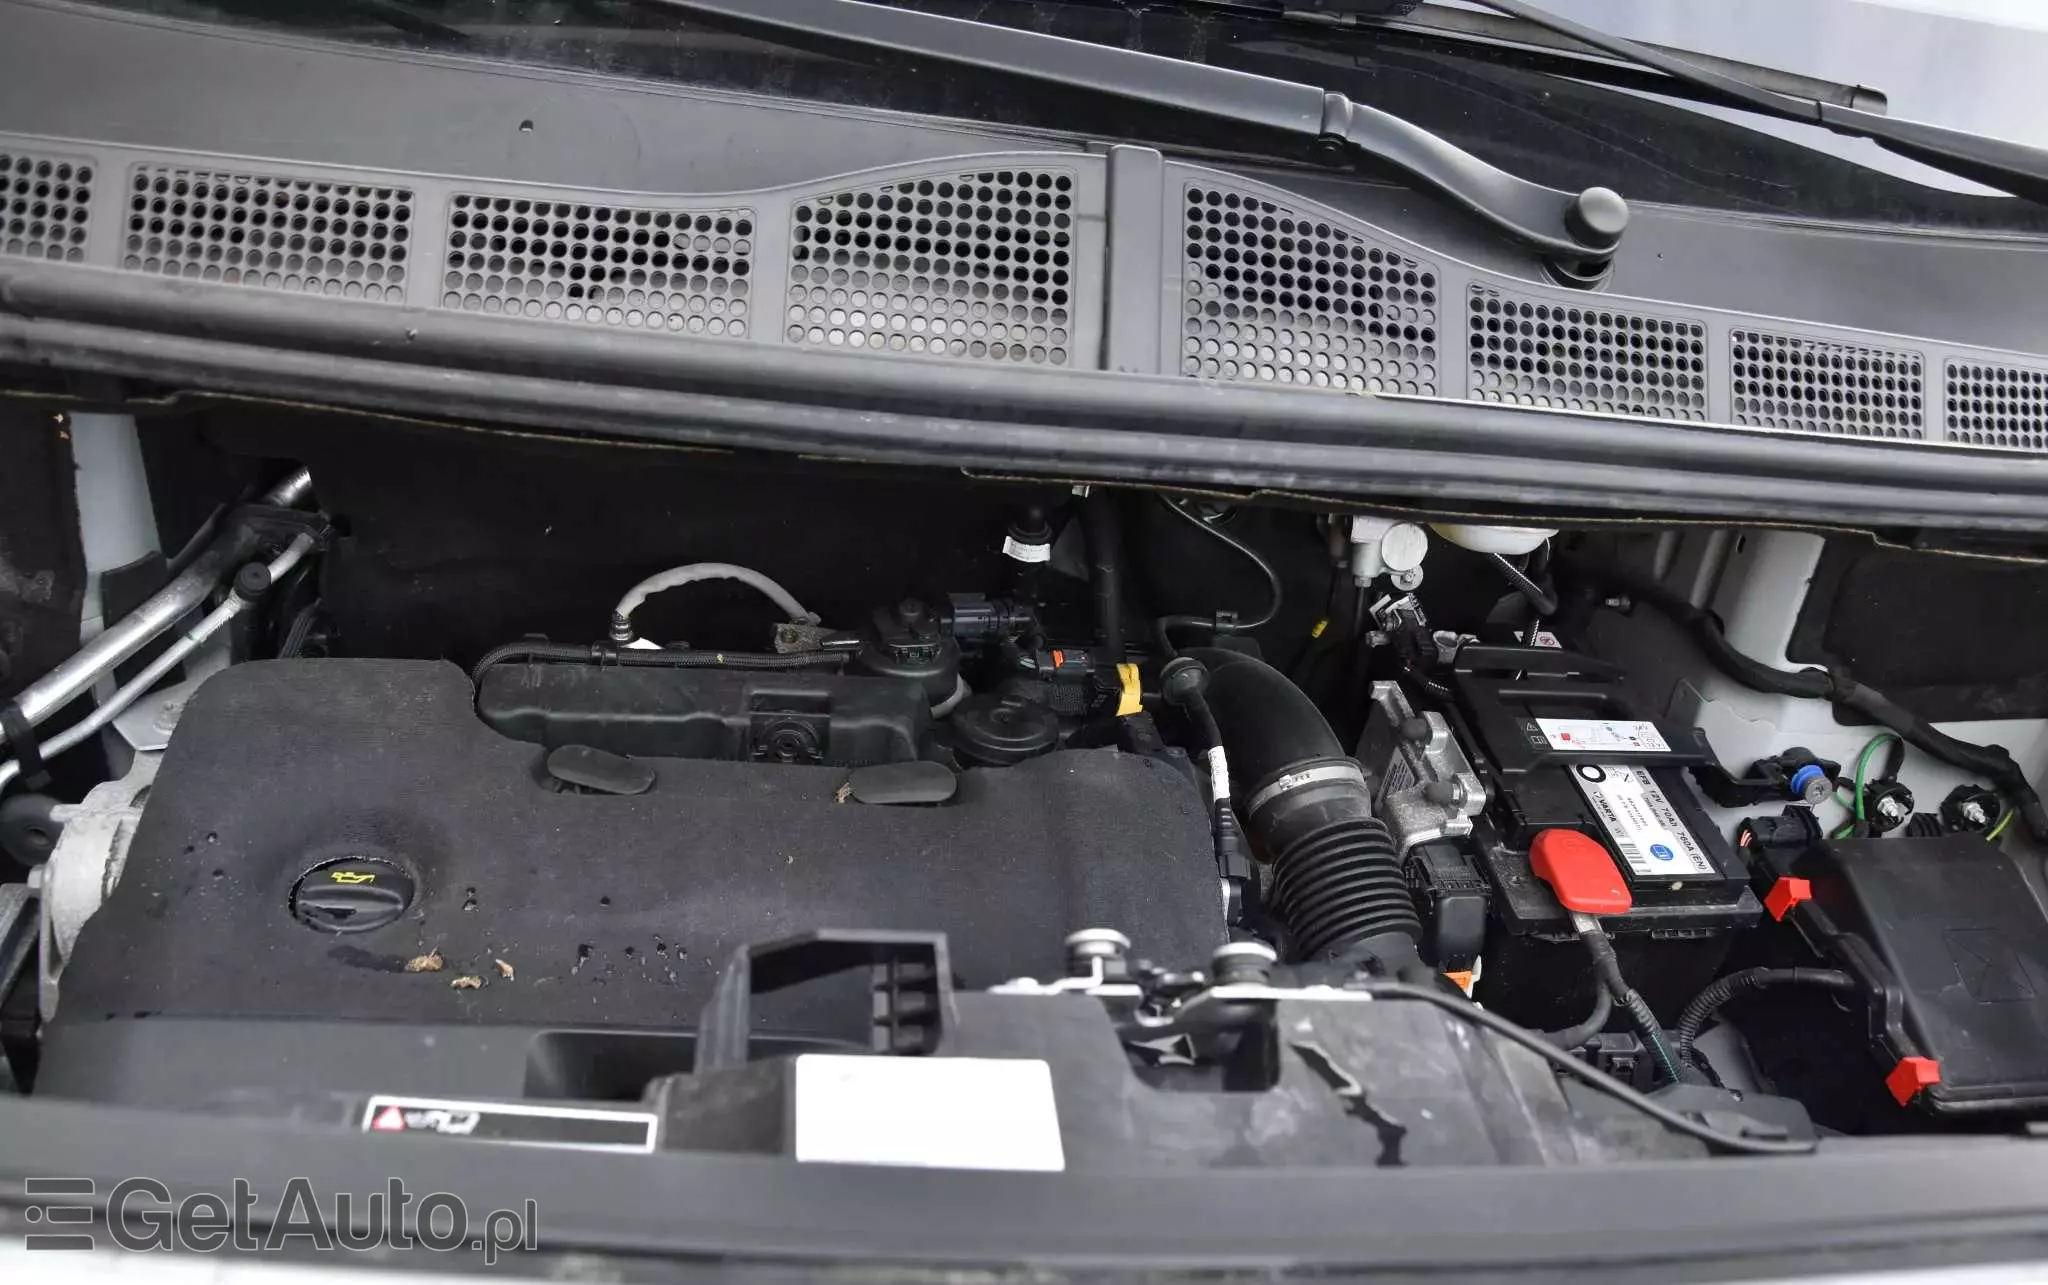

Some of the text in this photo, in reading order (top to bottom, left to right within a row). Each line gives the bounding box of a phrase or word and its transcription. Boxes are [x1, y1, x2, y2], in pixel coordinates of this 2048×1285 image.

[1599, 800, 1617, 822] VARTA
[1650, 790, 1665, 804] 12V
[1691, 852, 1707, 871] (EN)
